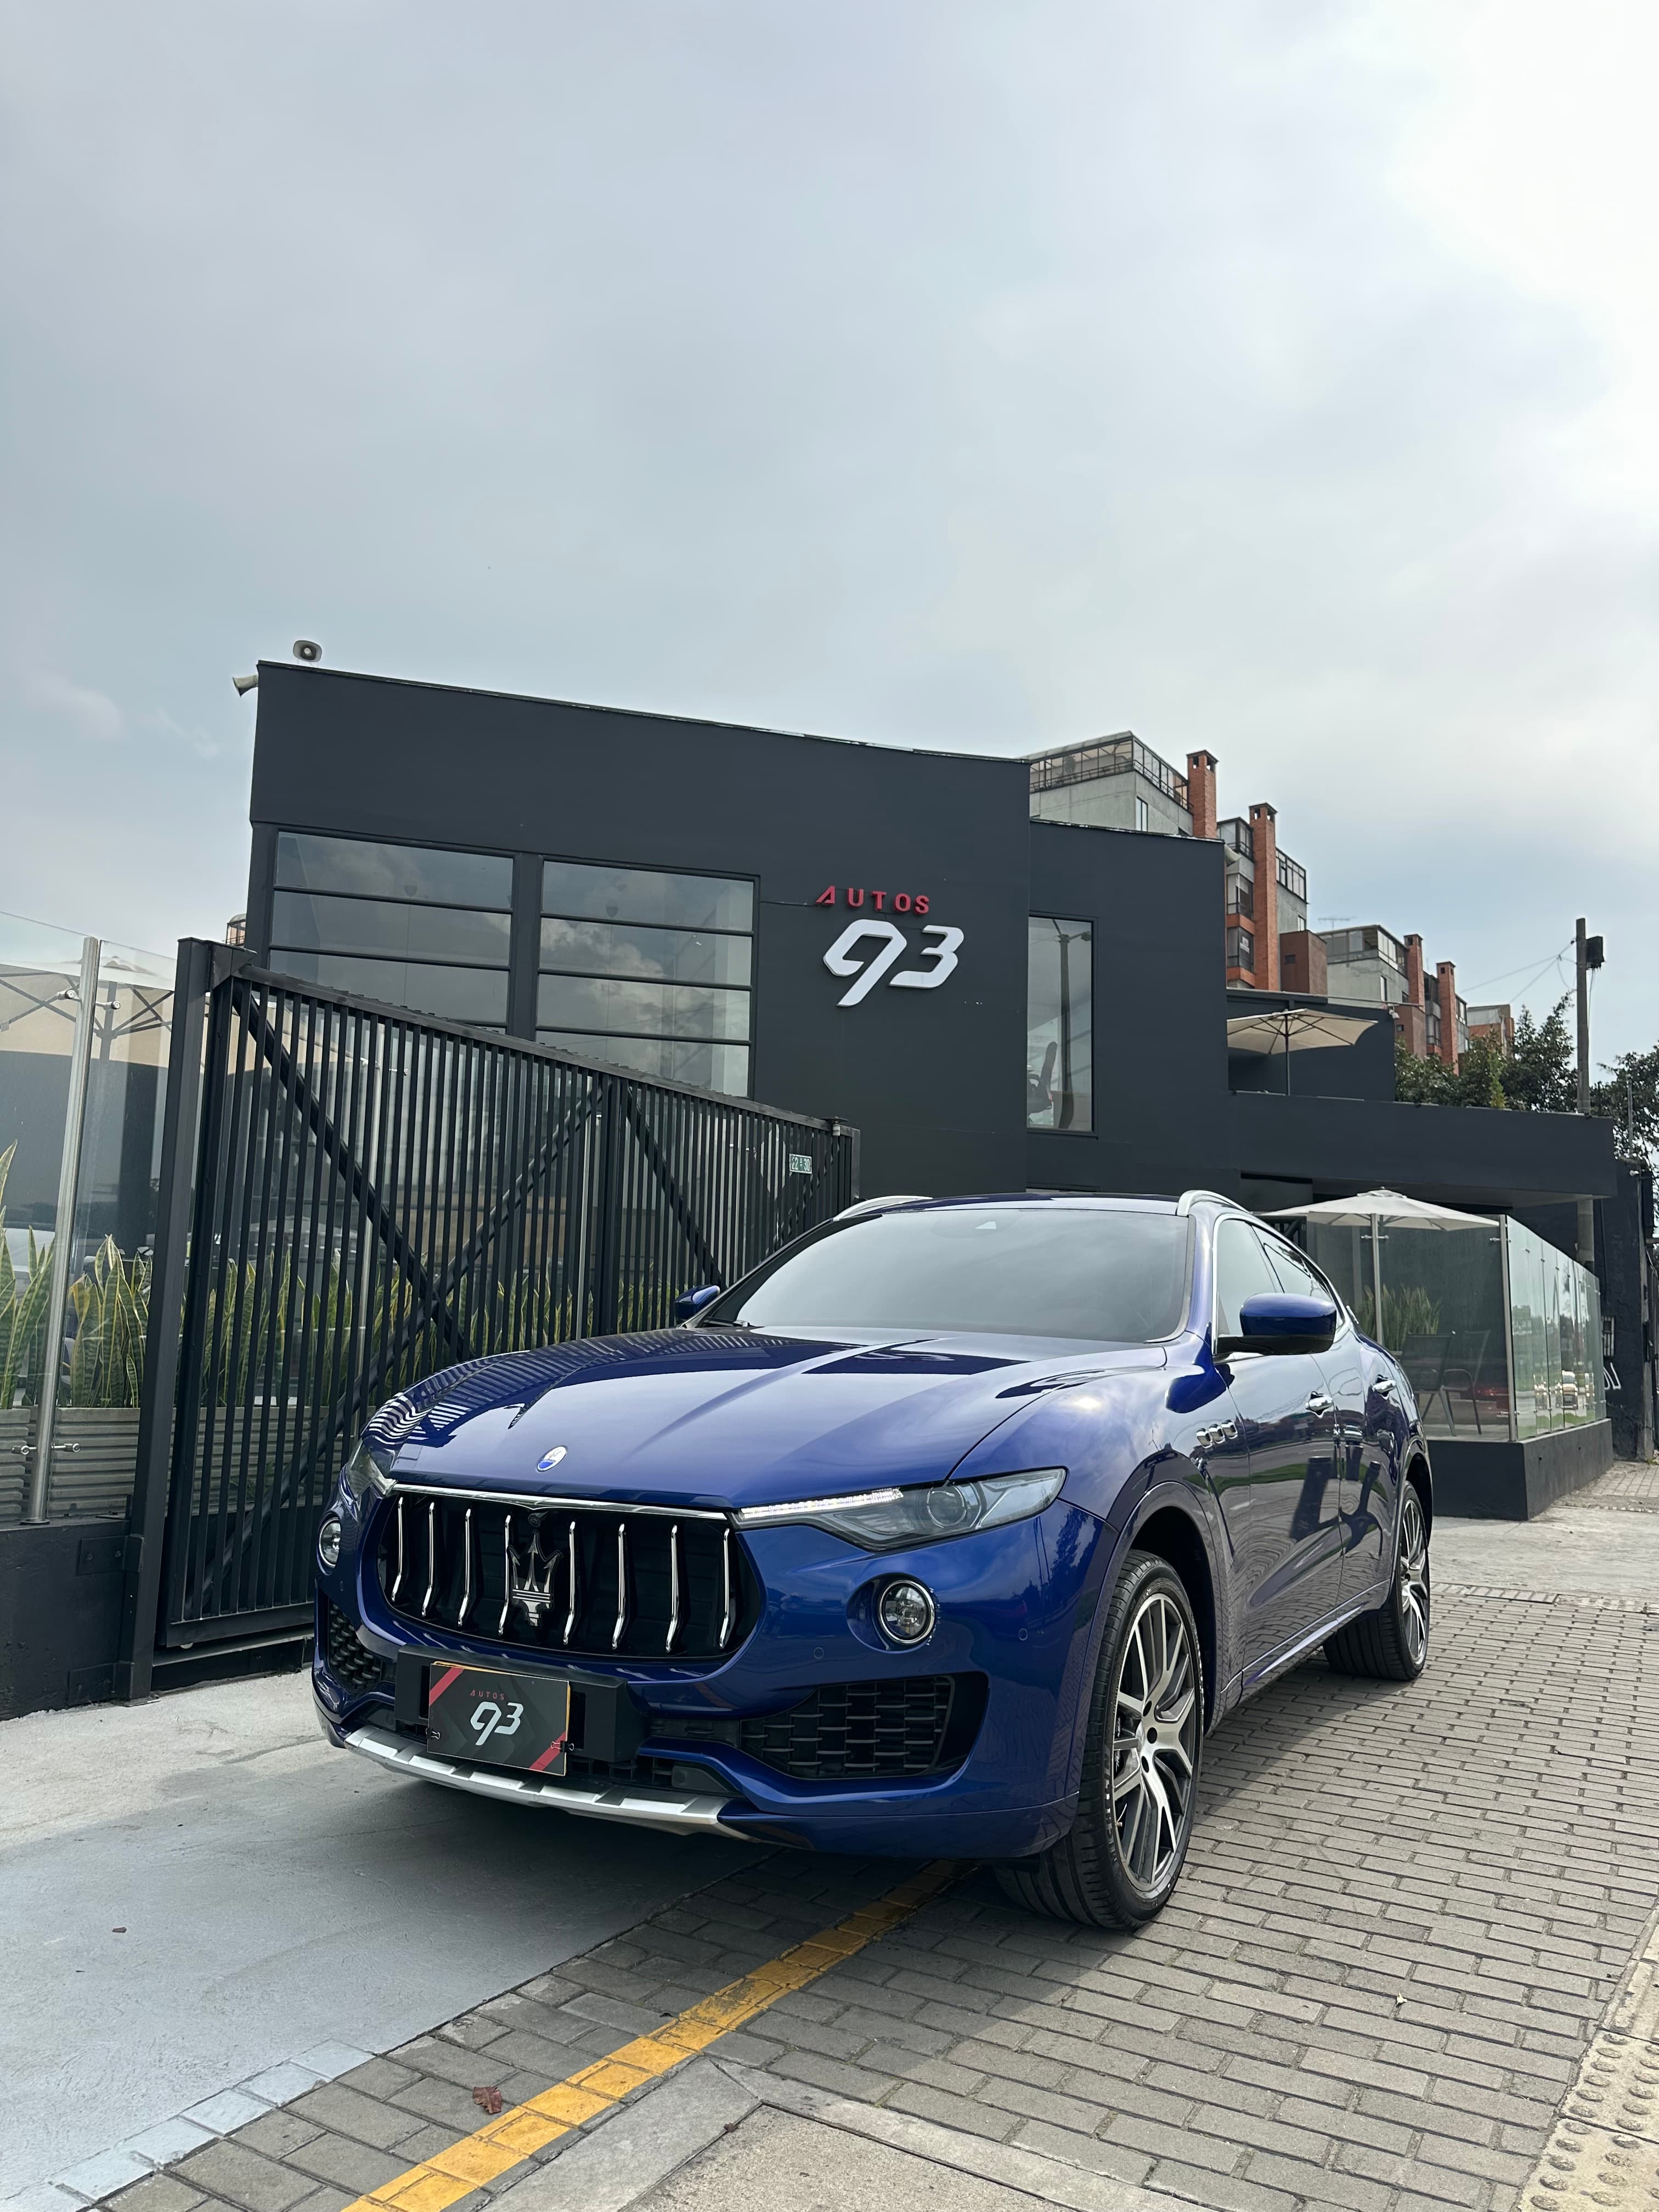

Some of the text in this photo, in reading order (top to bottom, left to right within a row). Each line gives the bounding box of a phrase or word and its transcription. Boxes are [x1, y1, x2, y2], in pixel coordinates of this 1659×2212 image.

[816, 885, 929, 914] AUTOS
[823, 919, 964, 1007] 93
[470, 1690, 505, 1700] AUTOS
[470, 1701, 523, 1746] 93
